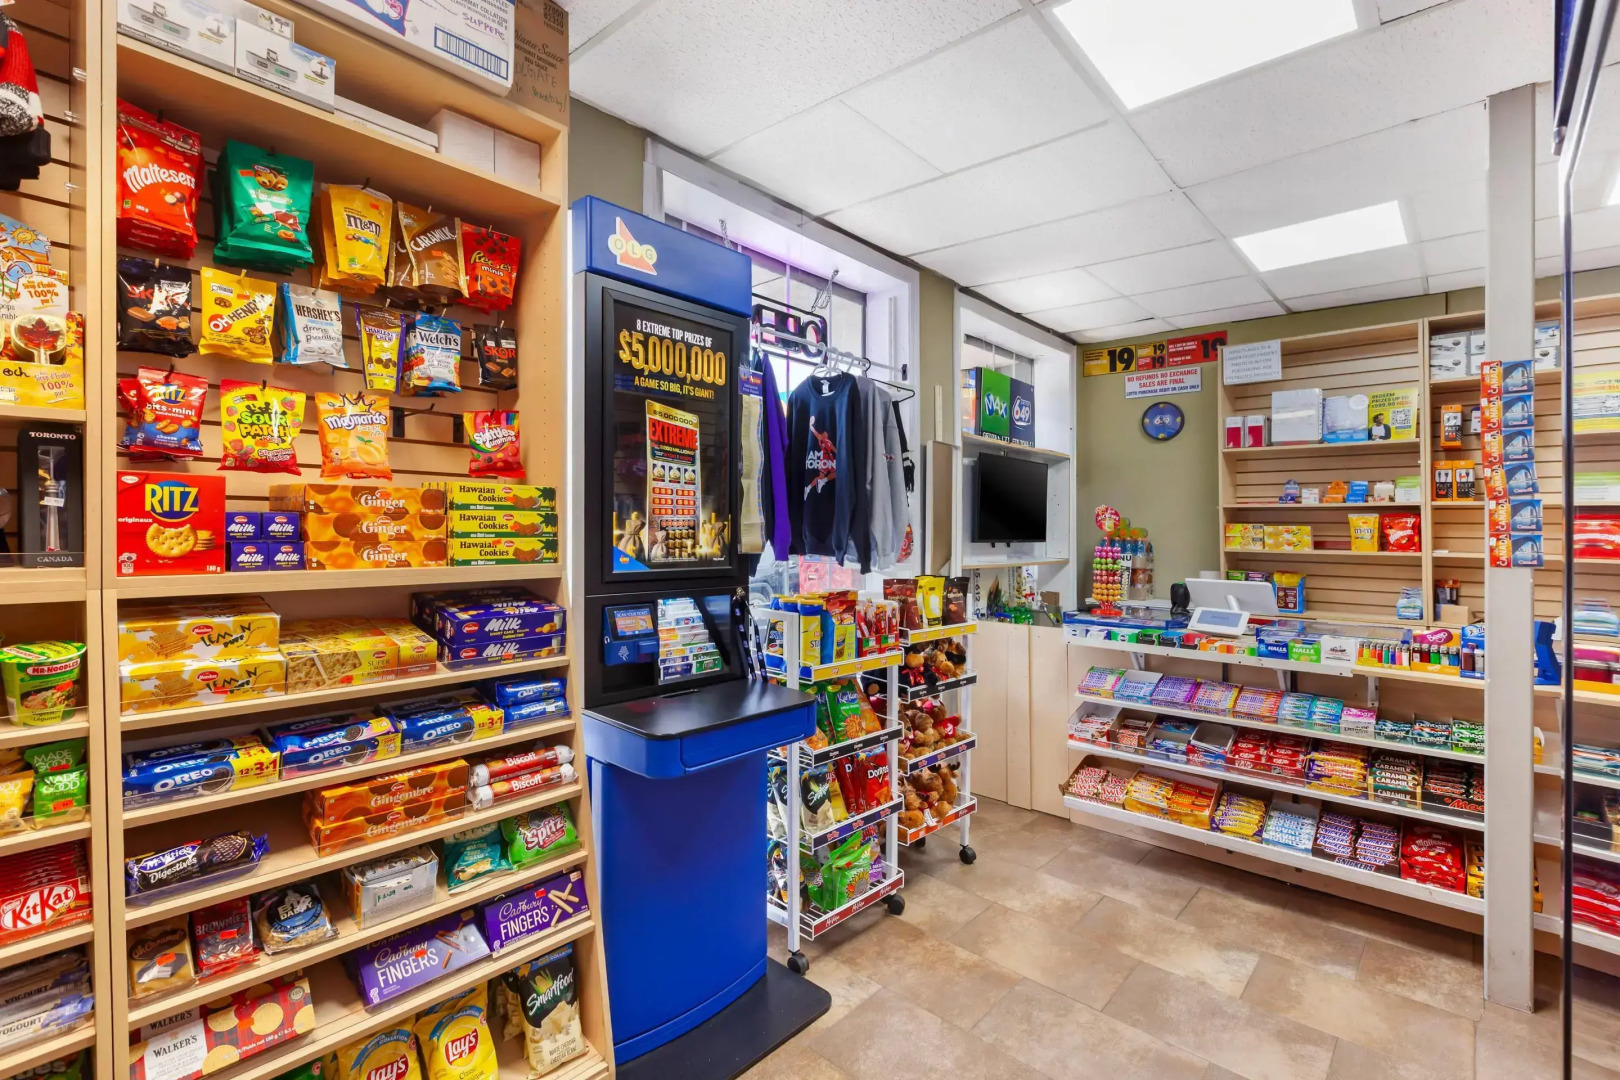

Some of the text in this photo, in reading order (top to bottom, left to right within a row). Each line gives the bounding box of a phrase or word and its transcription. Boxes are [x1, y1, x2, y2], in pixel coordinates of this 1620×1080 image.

[538, 43, 564, 64] Sauce
[123, 162, 196, 193] Maltesers
[411, 226, 455, 251] CARAMILK
[609, 234, 657, 264] OLG
[482, 265, 504, 277] minis
[28, 288, 59, 299] 100%
[296, 304, 341, 322] HERSHEY'S
[210, 315, 231, 332] OH
[418, 331, 459, 347] Welch's
[642, 320, 671, 338] EXTREME
[672, 328, 683, 340] TOP
[684, 332, 704, 346] PRIZES
[705, 337, 713, 348] OF
[484, 346, 516, 359] SKOR
[1153, 344, 1165, 355] 19
[619, 329, 726, 386] $5,000,000
[1108, 348, 1135, 372] 19
[1152, 356, 1165, 369] 19
[1136, 374, 1159, 382] REFUNDS
[1170, 368, 1198, 378] EXCHANGE
[40, 382, 74, 392] 100%
[640, 378, 659, 389] GAME
[660, 381, 669, 392] SO
[670, 382, 682, 395] BIG,
[683, 386, 694, 397] IT'S
[694, 388, 714, 400] GIANT!
[1138, 380, 1155, 388] SALES
[1156, 379, 1168, 387] ARE
[1138, 388, 1158, 396] PURCHASE
[172, 406, 195, 416] mini
[985, 392, 1008, 419] MAX
[240, 412, 288, 426] SOUR
[29, 432, 76, 440] TORONTO
[240, 424, 289, 437] PATCH
[474, 424, 515, 446] Skittles
[648, 417, 698, 451] EXTREME
[460, 485, 496, 494] Hawaian
[144, 484, 199, 513] RITZ
[361, 494, 405, 512] Ginger
[460, 514, 496, 522] Hawaian
[228, 523, 256, 533] Milk
[268, 522, 295, 533] Milk
[362, 522, 407, 539] Ginger
[479, 522, 509, 530] Cookies
[460, 541, 497, 549] Hawaian
[236, 553, 264, 563] Milk
[274, 552, 300, 562] Milk
[363, 550, 408, 567] Ginger
[480, 549, 509, 557] Cookies
[484, 618, 522, 632] Milk
[1427, 632, 1448, 643] Beep
[1268, 645, 1288, 653] HALLS
[49, 659, 79, 673] NOODLES
[423, 722, 461, 740] OREO
[34, 750, 72, 763] MADE
[308, 746, 352, 764] OREO
[506, 752, 536, 767] Biscoff
[1380, 755, 1417, 765] CARAMILK
[36, 758, 73, 772] GOOD
[868, 765, 890, 779] Doritos
[1375, 762, 1412, 773] CARAMILK
[44, 772, 80, 784] MADE
[152, 768, 213, 792] OREO
[1376, 770, 1414, 781] CARAMILK
[1376, 777, 1414, 787] CARAMILK
[42, 781, 80, 794] GOOD
[512, 775, 542, 791] Biscoff
[371, 785, 434, 809] Gingembre
[366, 813, 430, 839] Gingembre
[526, 815, 565, 849] Spitz
[1319, 822, 1350, 833] SNICKERS
[1318, 834, 1349, 845] SNICKERS
[1319, 828, 1350, 840] SNICKERS
[1318, 839, 1353, 851] SNICKERS
[149, 857, 198, 884] Digestives
[1336, 856, 1376, 872] SNICKERS
[12, 886, 71, 928] KitKat
[498, 898, 544, 922] Cadbury
[195, 914, 248, 935] BROWNIES
[500, 906, 549, 941] FINGERS
[378, 948, 439, 988] FINGERS
[6, 984, 50, 1005] YOGOURT
[526, 966, 574, 1016] Smartfood
[150, 1010, 193, 1031] WALKER'S
[153, 1034, 199, 1059] WALKER'S
[449, 1032, 477, 1062] Lay's
[561, 1038, 576, 1050] CHEDDAR
